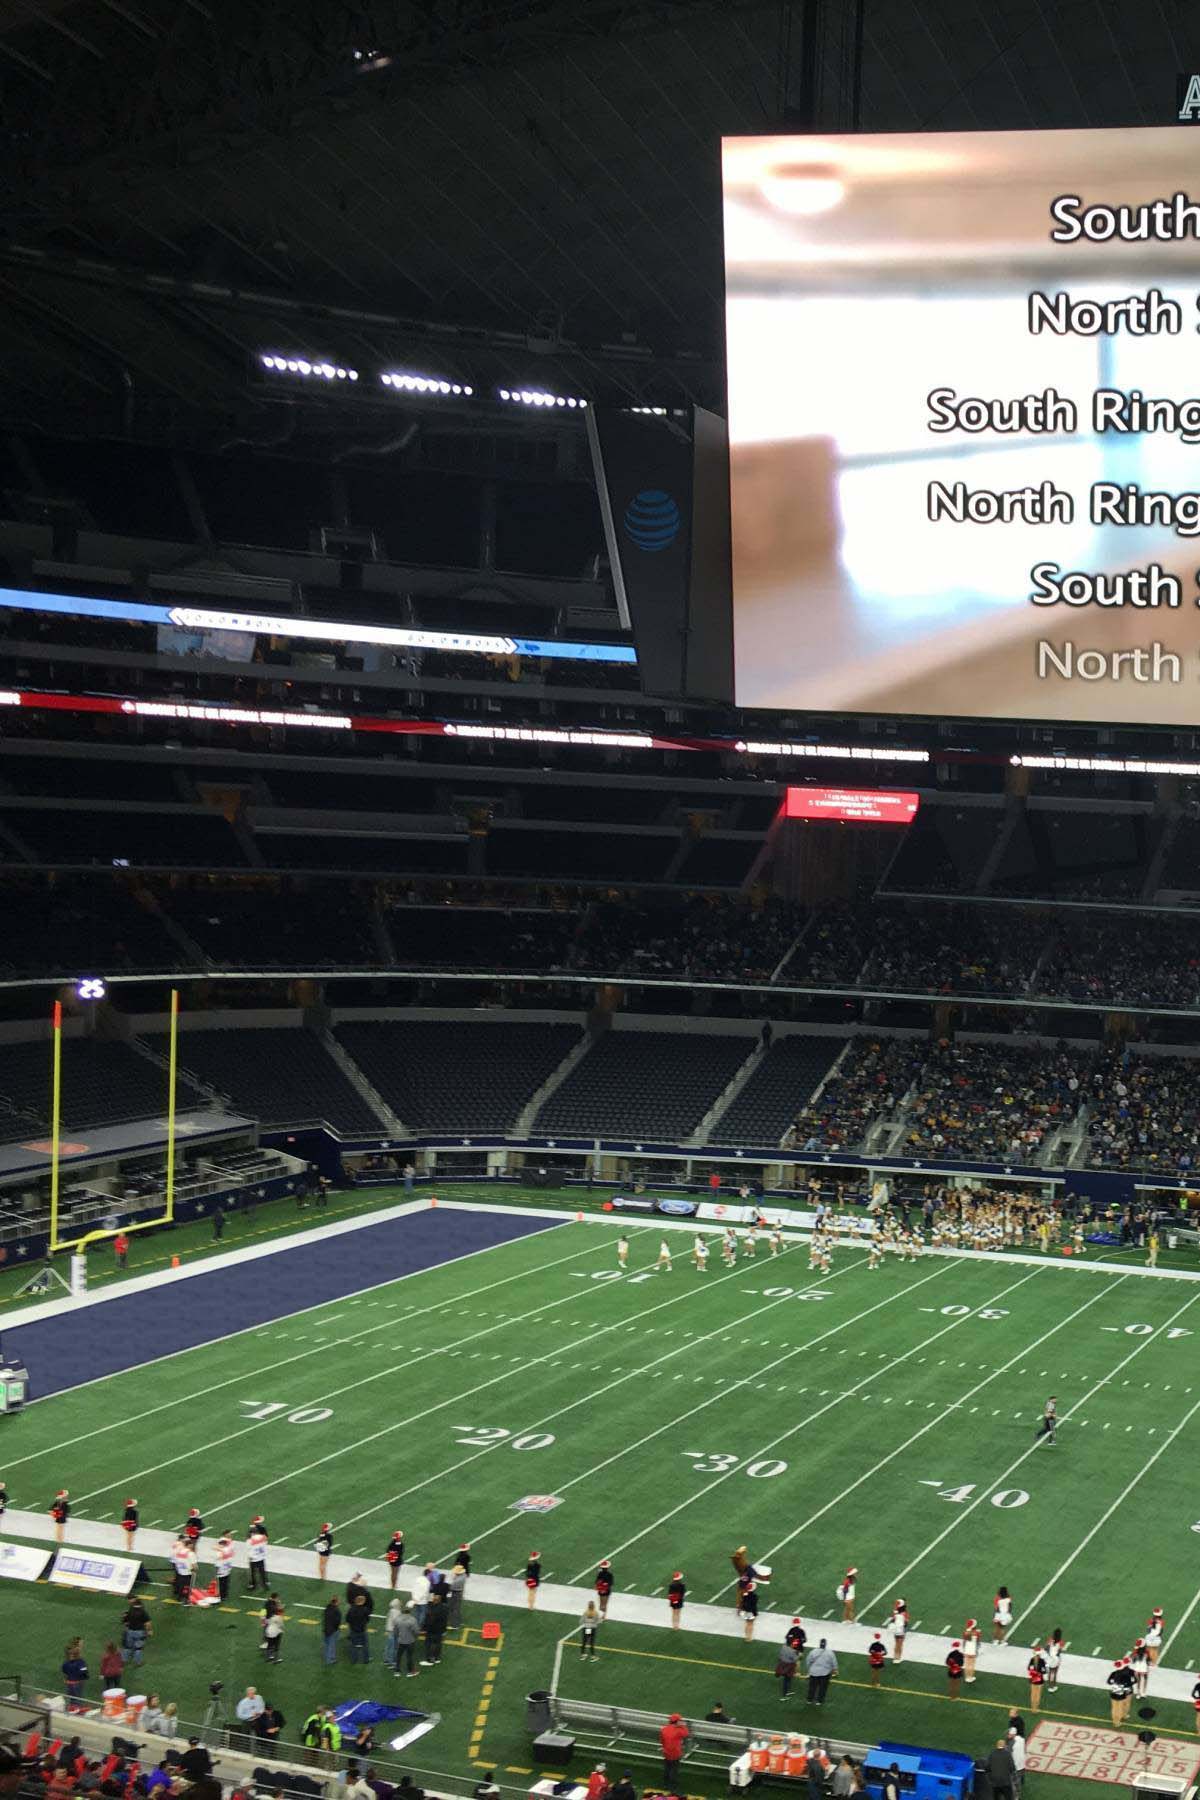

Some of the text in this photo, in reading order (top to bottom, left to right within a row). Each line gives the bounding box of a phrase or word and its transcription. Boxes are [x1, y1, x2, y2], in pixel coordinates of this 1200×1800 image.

[1031, 290, 1180, 334] North
[927, 387, 1078, 432] South
[929, 482, 1074, 523] North
[1032, 564, 1179, 607] South
[1038, 640, 1181, 683] North
[242, 1403, 334, 1425] 10
[455, 1427, 555, 1450] 20
[693, 1453, 788, 1478] 30
[936, 1484, 1030, 1509] 40
[1053, 1726, 1126, 1748] HOKA
[1025, 1756, 1042, 1768] 6
[1061, 1762, 1077, 1773] 7
[1092, 1767, 1110, 1779] 8
[1039, 1741, 1188, 1774] 1 2 3 4 5
